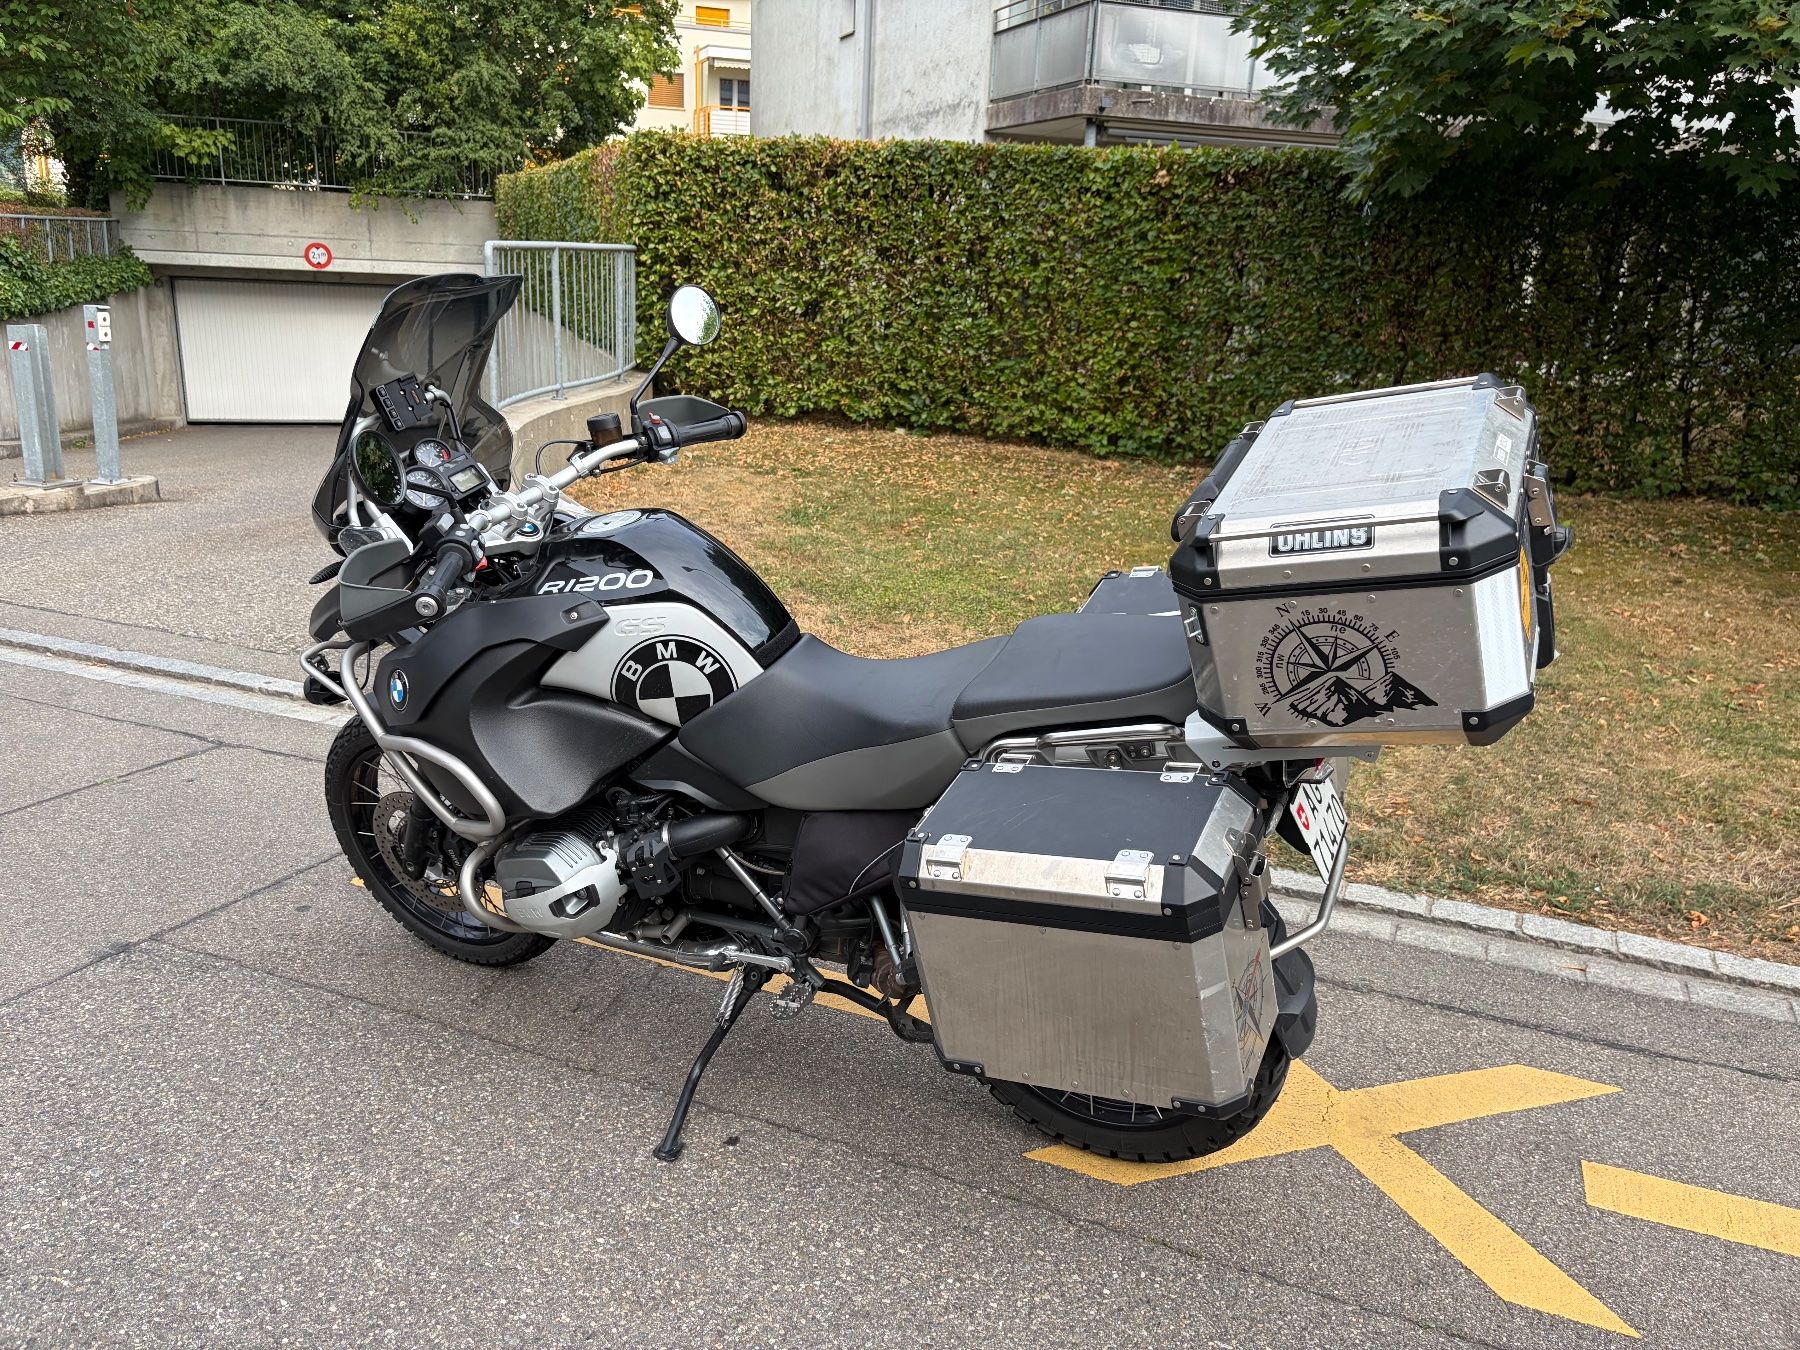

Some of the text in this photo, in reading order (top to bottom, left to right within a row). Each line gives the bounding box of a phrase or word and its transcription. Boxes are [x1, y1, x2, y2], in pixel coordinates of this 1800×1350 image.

[537, 569, 654, 595] R1200
[1275, 603, 1291, 617] N
[1336, 609, 1347, 617] 45
[1330, 624, 1346, 634] ne
[1369, 622, 1379, 632] 75
[1260, 636, 1270, 649] 330
[1384, 629, 1400, 643] E
[620, 641, 720, 682] BMW
[1256, 651, 1265, 663] 315
[1254, 702, 1272, 717] W
[1302, 783, 1323, 821] AG
[1313, 793, 1346, 875] 71470
